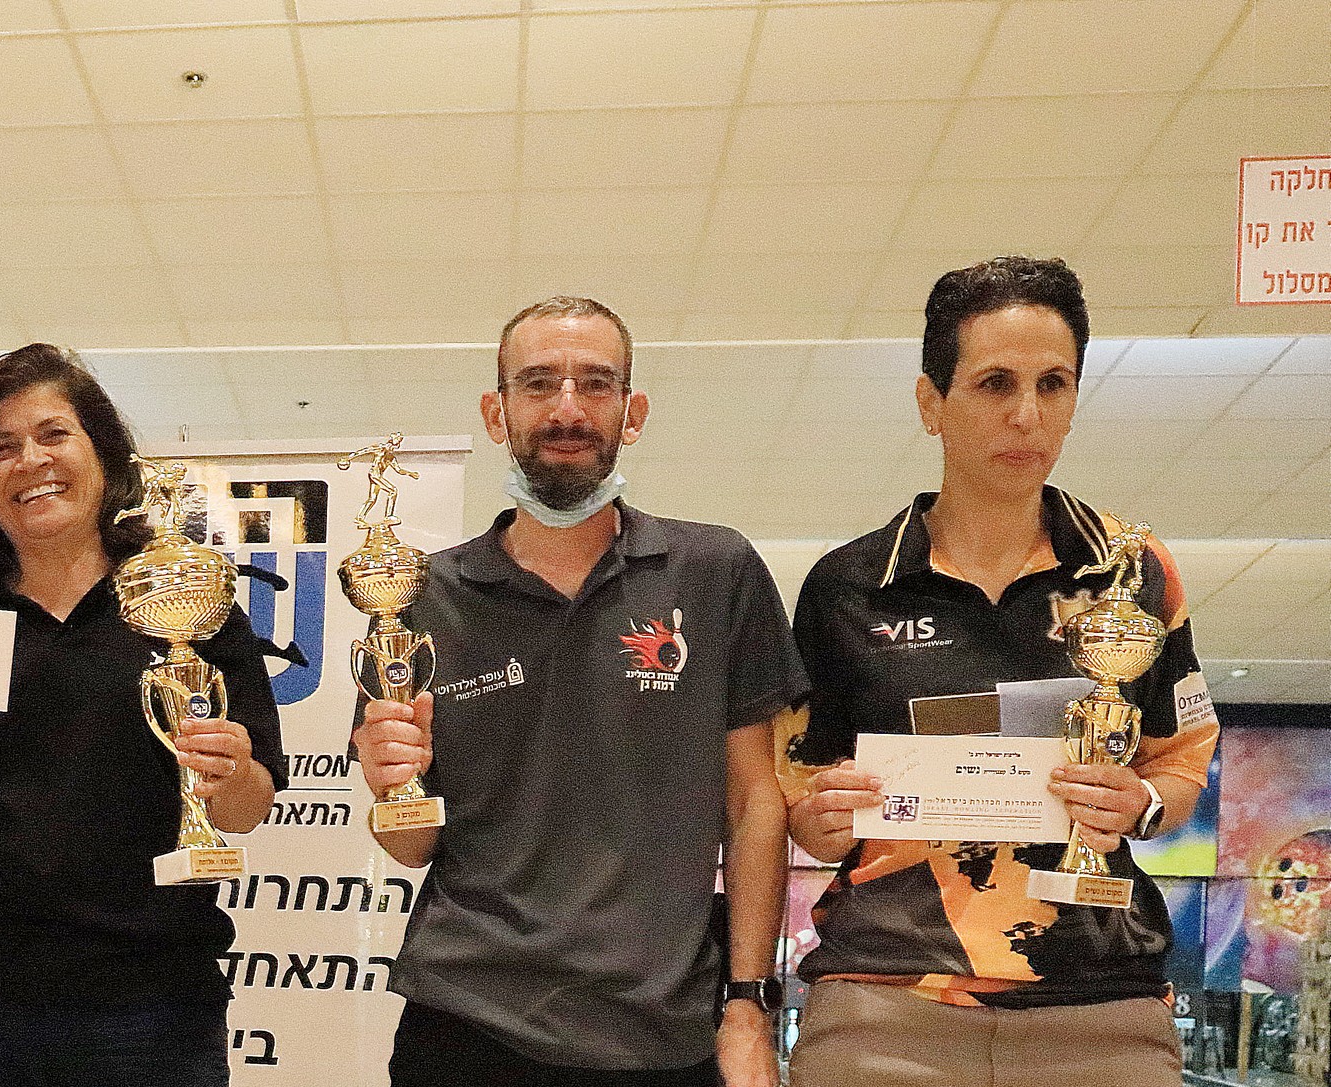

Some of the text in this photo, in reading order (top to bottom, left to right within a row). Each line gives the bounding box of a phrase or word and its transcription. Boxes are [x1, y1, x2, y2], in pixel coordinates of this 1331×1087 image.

[1247, 221, 1315, 249] את קו
[1263, 269, 1331, 294] מסלול
[876, 616, 936, 642] VIS
[908, 640, 954, 650] SportWear
[435, 670, 505, 695] עופר אלדרוטי
[640, 680, 675, 692] רמת גן
[456, 688, 481, 701] לביטוח
[956, 766, 980, 774] נשים
[1009, 765, 1017, 775] 3
